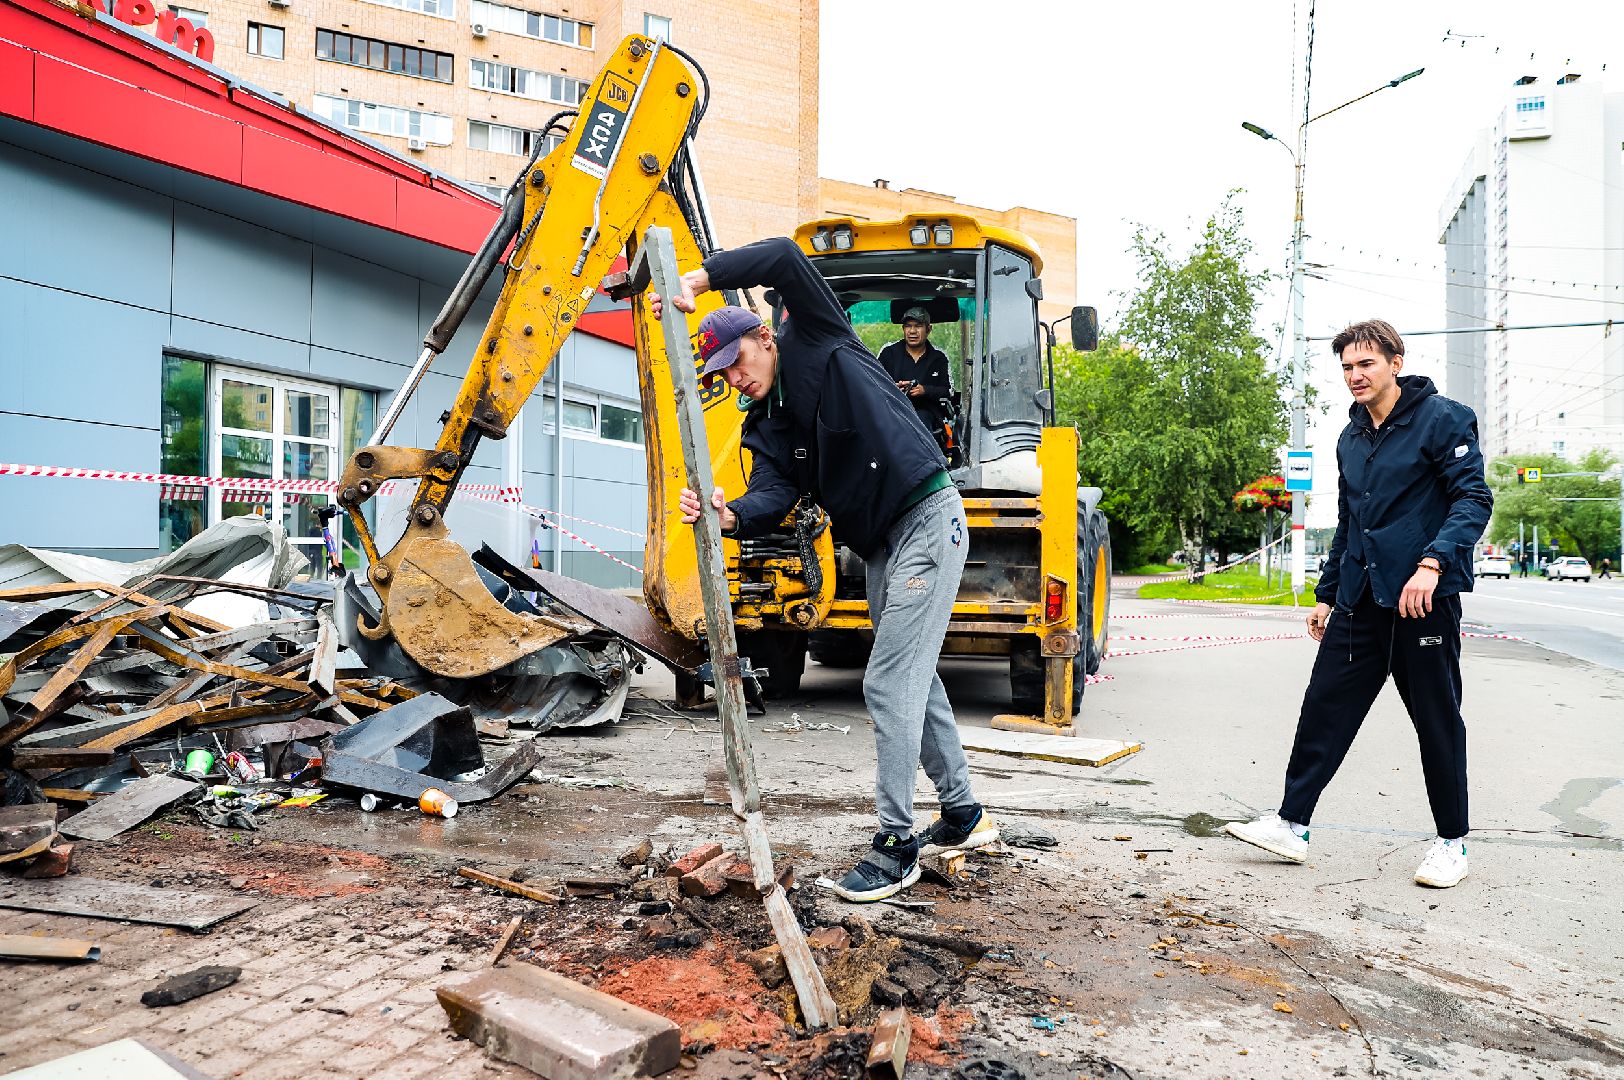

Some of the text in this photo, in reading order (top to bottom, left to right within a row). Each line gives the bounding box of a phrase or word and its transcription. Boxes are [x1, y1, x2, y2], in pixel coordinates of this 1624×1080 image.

[608, 82, 628, 102] JCB
[584, 111, 616, 160] 4CX
[951, 517, 963, 549] 3
